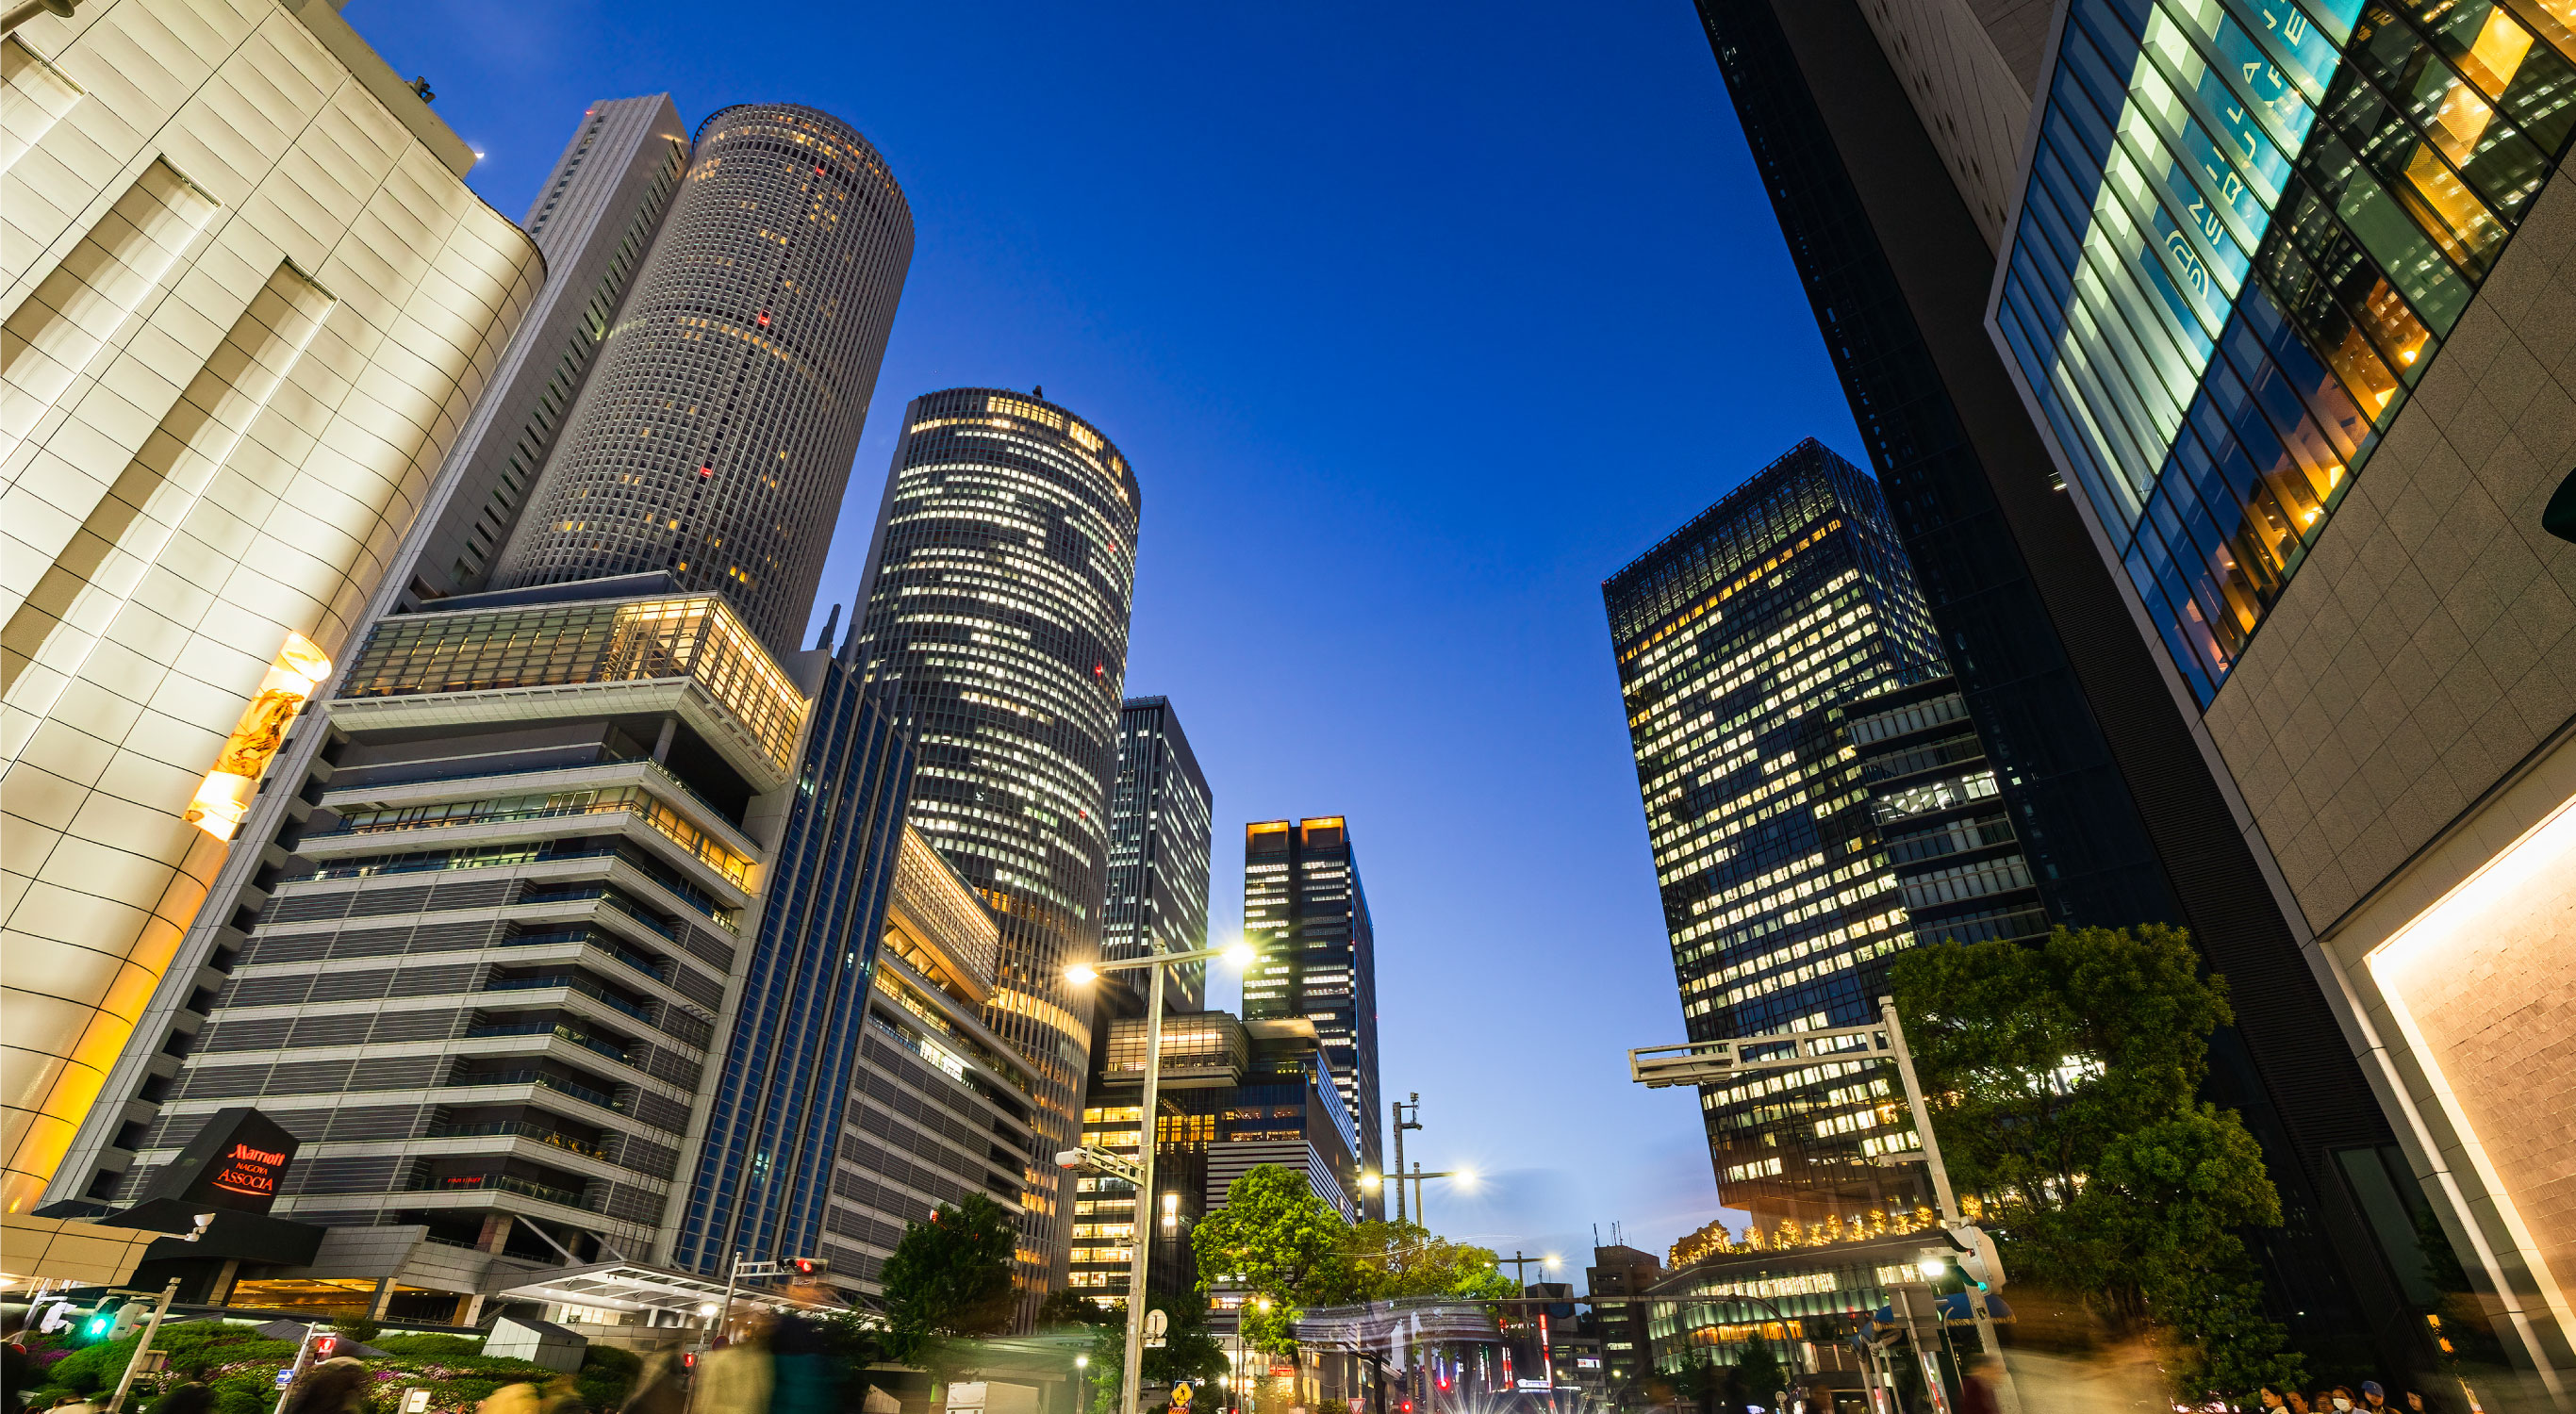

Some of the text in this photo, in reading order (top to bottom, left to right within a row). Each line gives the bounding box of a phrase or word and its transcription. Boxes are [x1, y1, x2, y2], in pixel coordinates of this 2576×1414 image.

[227, 1143, 286, 1167] Marriott
[217, 1168, 273, 1191] ASSOCIA
[236, 1161, 268, 1176] NAGOYA
